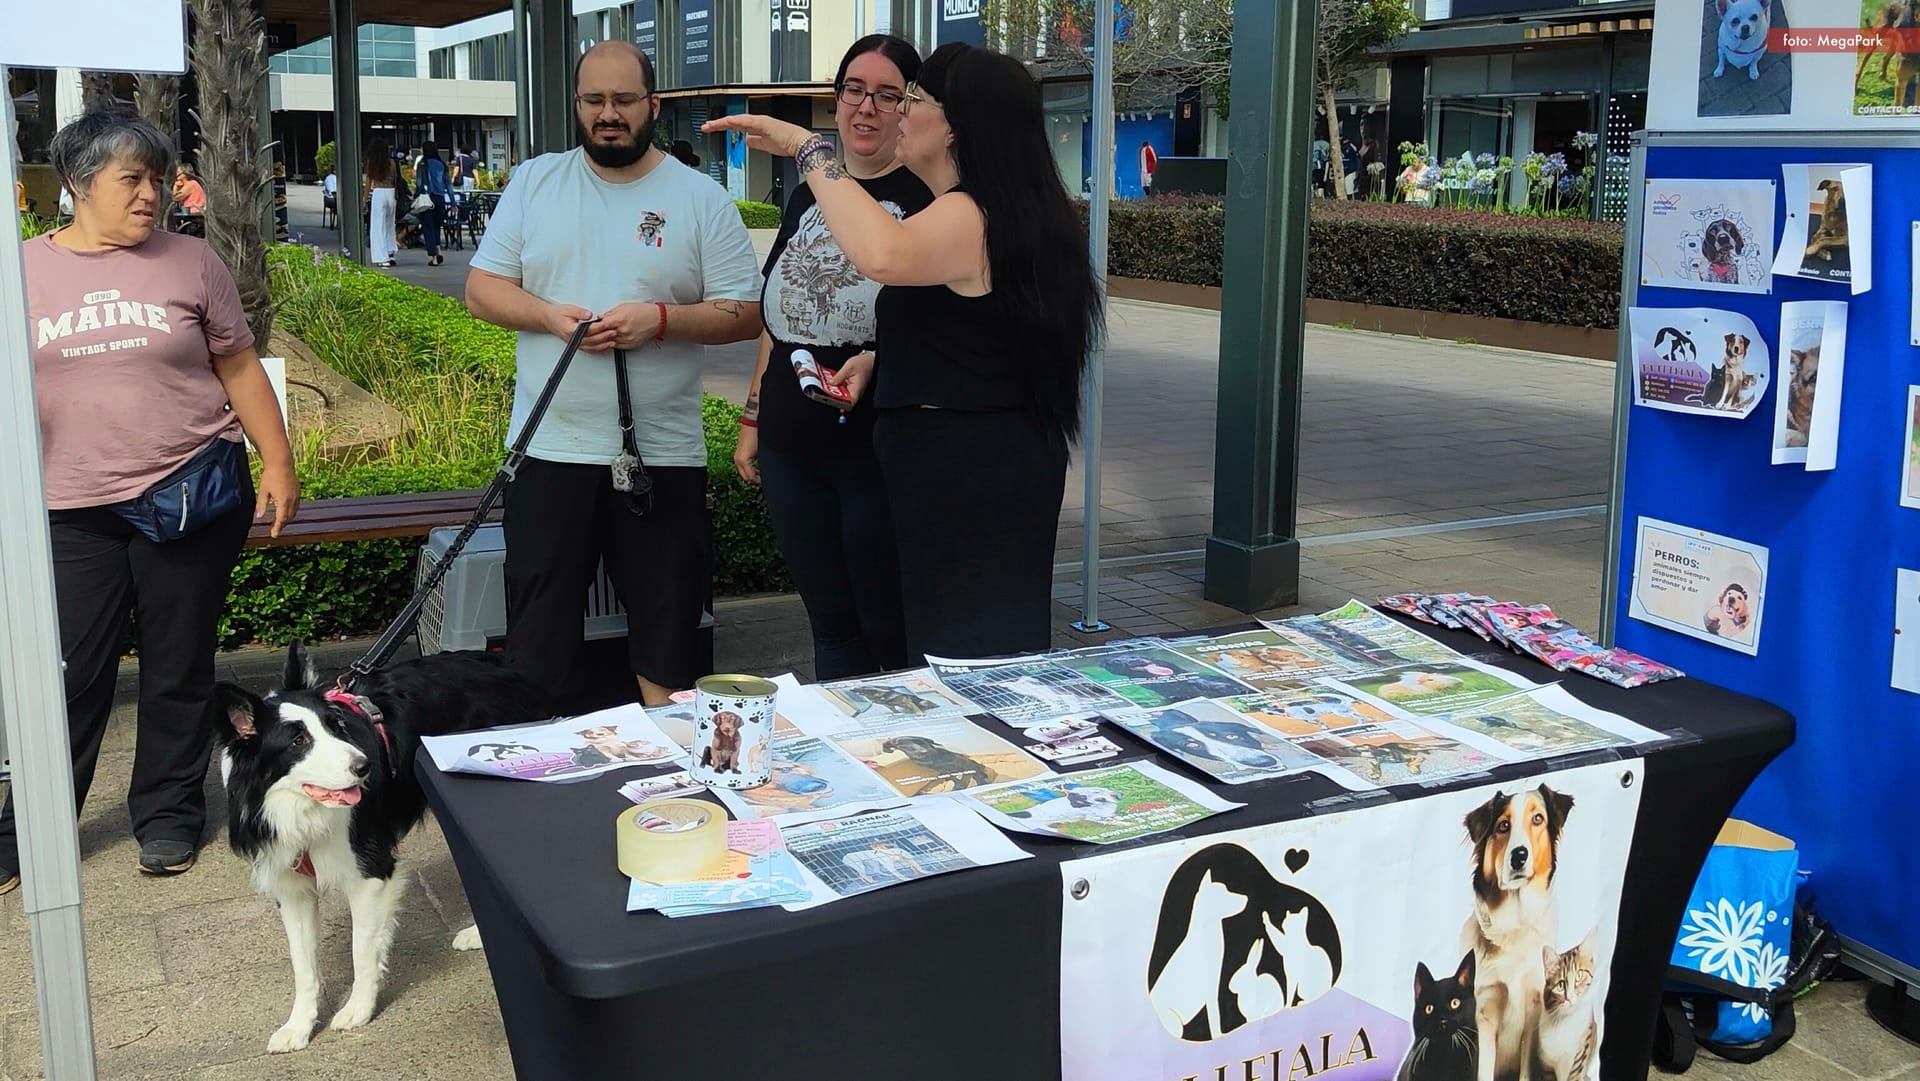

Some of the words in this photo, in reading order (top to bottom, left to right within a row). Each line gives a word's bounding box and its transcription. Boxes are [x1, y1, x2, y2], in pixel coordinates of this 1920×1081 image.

[90, 291, 112, 302] 1990
[37, 301, 171, 349] MAINE
[60, 343, 107, 358] VINTAGE
[109, 337, 148, 351] SPORTS
[1654, 549, 1699, 569] PERROS:
[1652, 568, 1687, 583] dispuestos
[1653, 562, 1682, 574] animales
[1684, 569, 1711, 582] siempre
[1651, 576, 1680, 588] perdonar
[840, 813, 890, 826] RAGNAR
